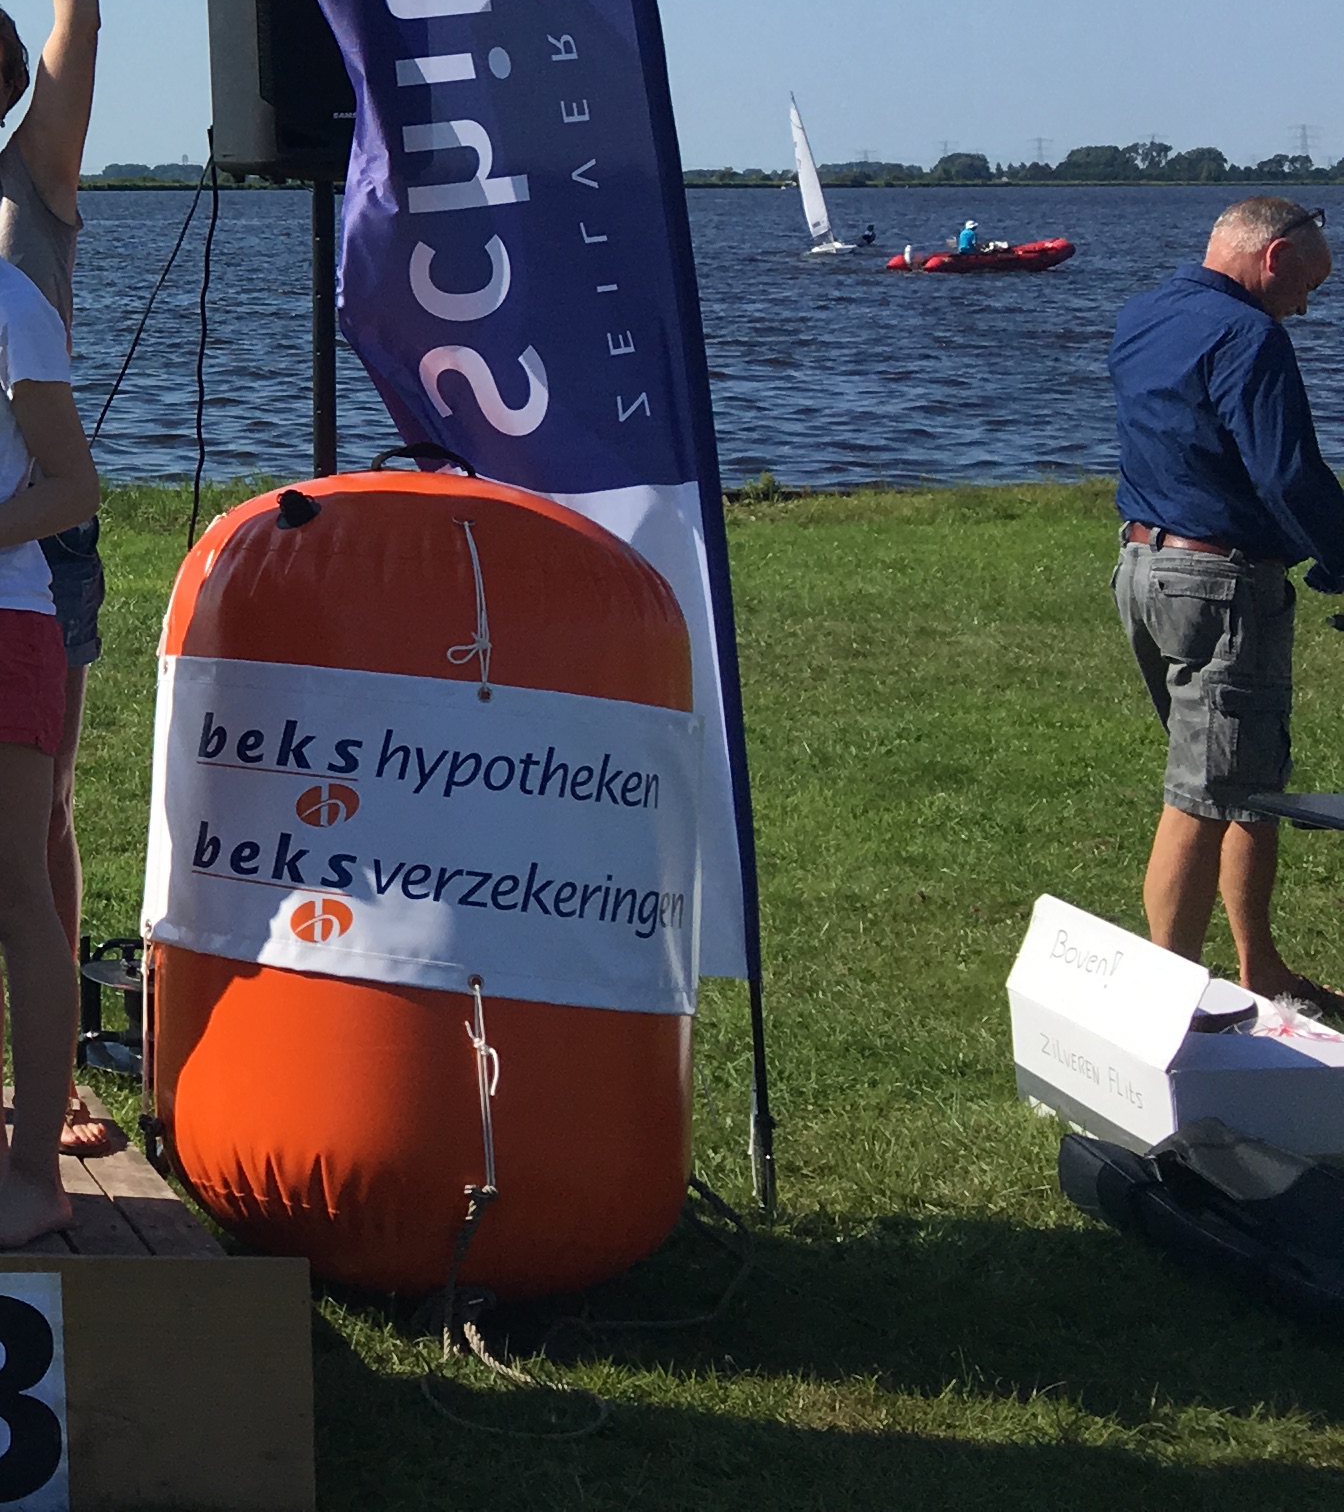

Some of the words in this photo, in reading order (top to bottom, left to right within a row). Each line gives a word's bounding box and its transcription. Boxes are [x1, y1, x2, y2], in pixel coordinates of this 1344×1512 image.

[197, 712, 364, 774] beks
[375, 729, 661, 809] hypotheken
[191, 821, 358, 889] beks
